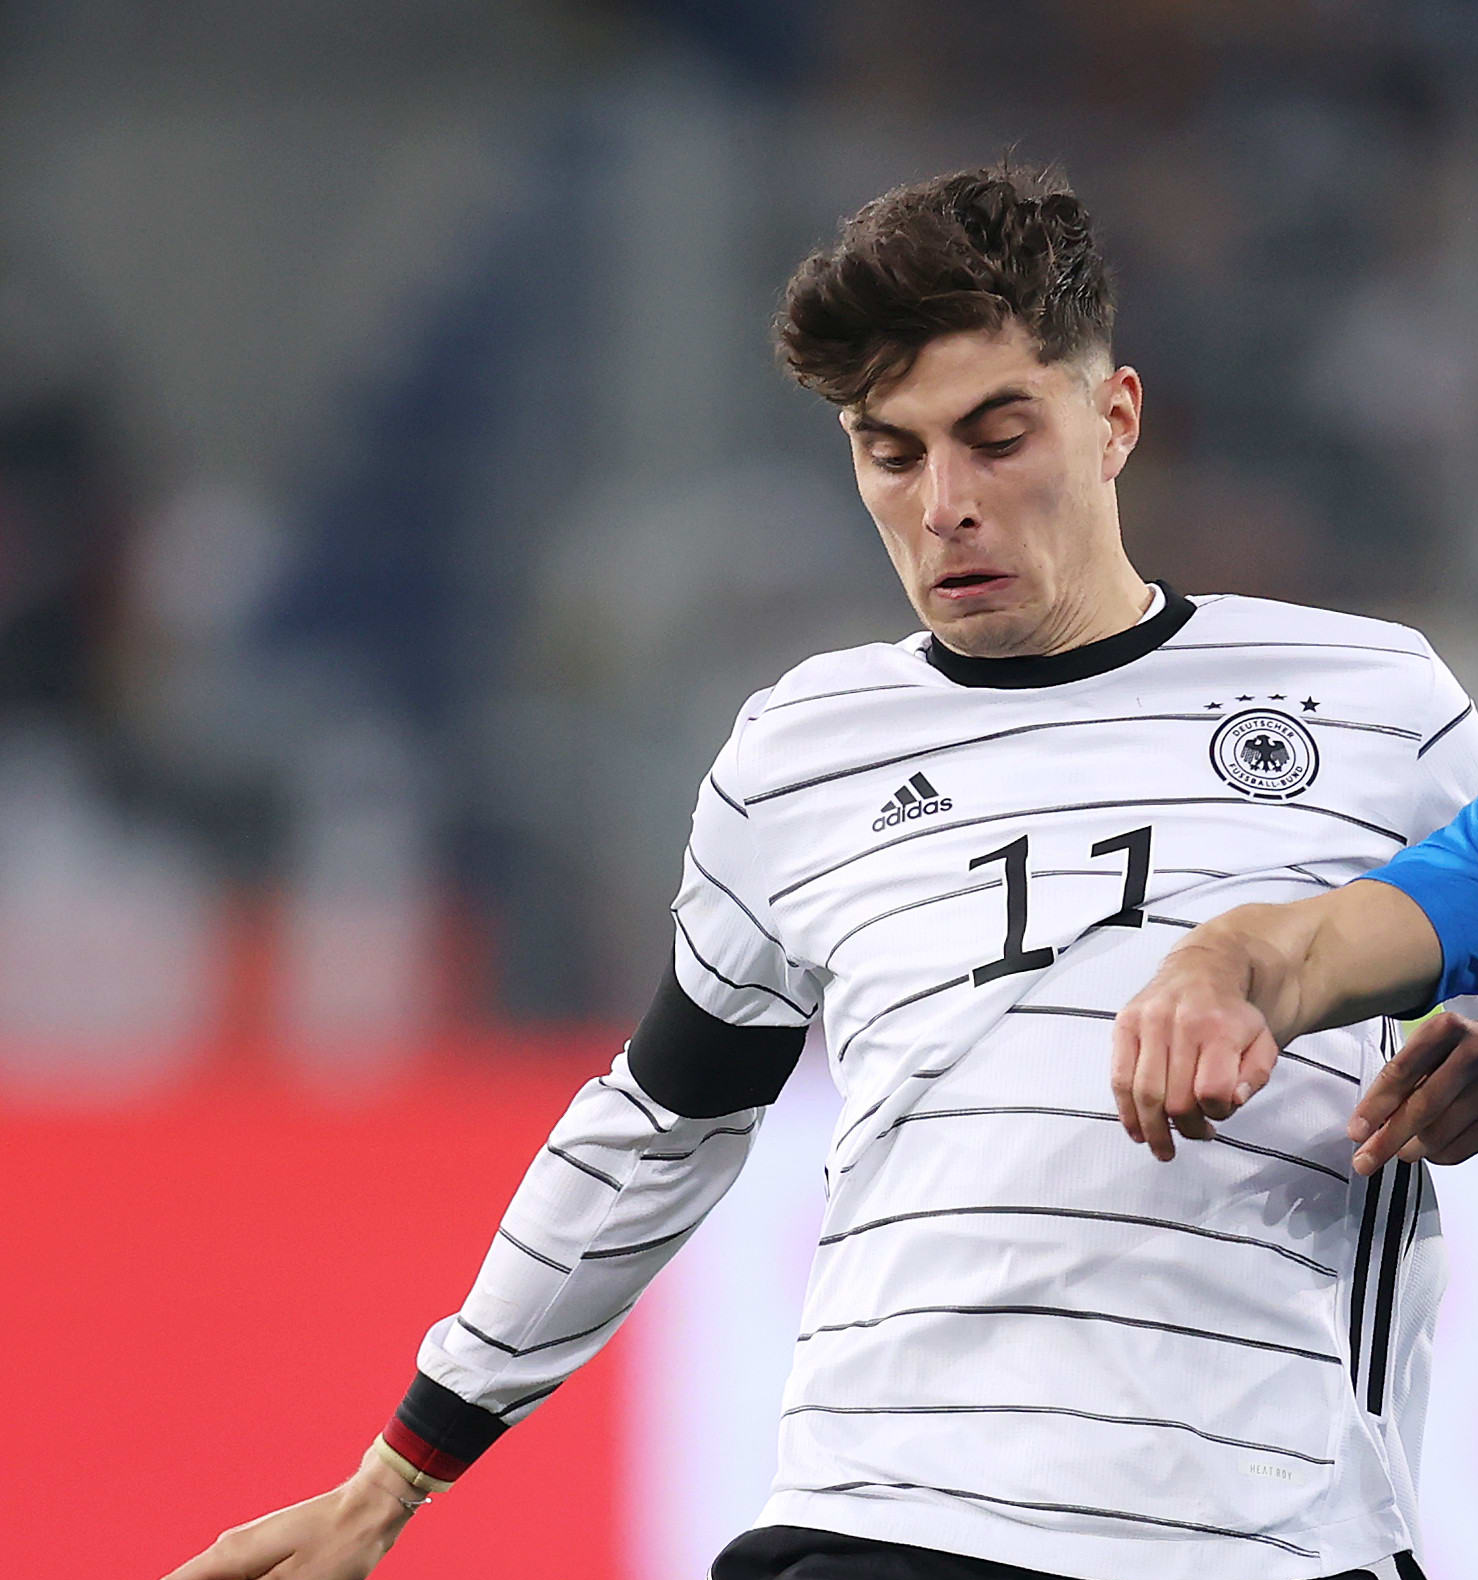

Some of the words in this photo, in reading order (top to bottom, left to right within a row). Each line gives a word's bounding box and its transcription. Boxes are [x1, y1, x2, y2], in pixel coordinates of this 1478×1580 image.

[1232, 720, 1295, 739] DEUTSCHER
[1228, 763, 1304, 788] FUSSBALL-BUND
[872, 797, 953, 832] adidas
[969, 825, 1152, 988] 11
